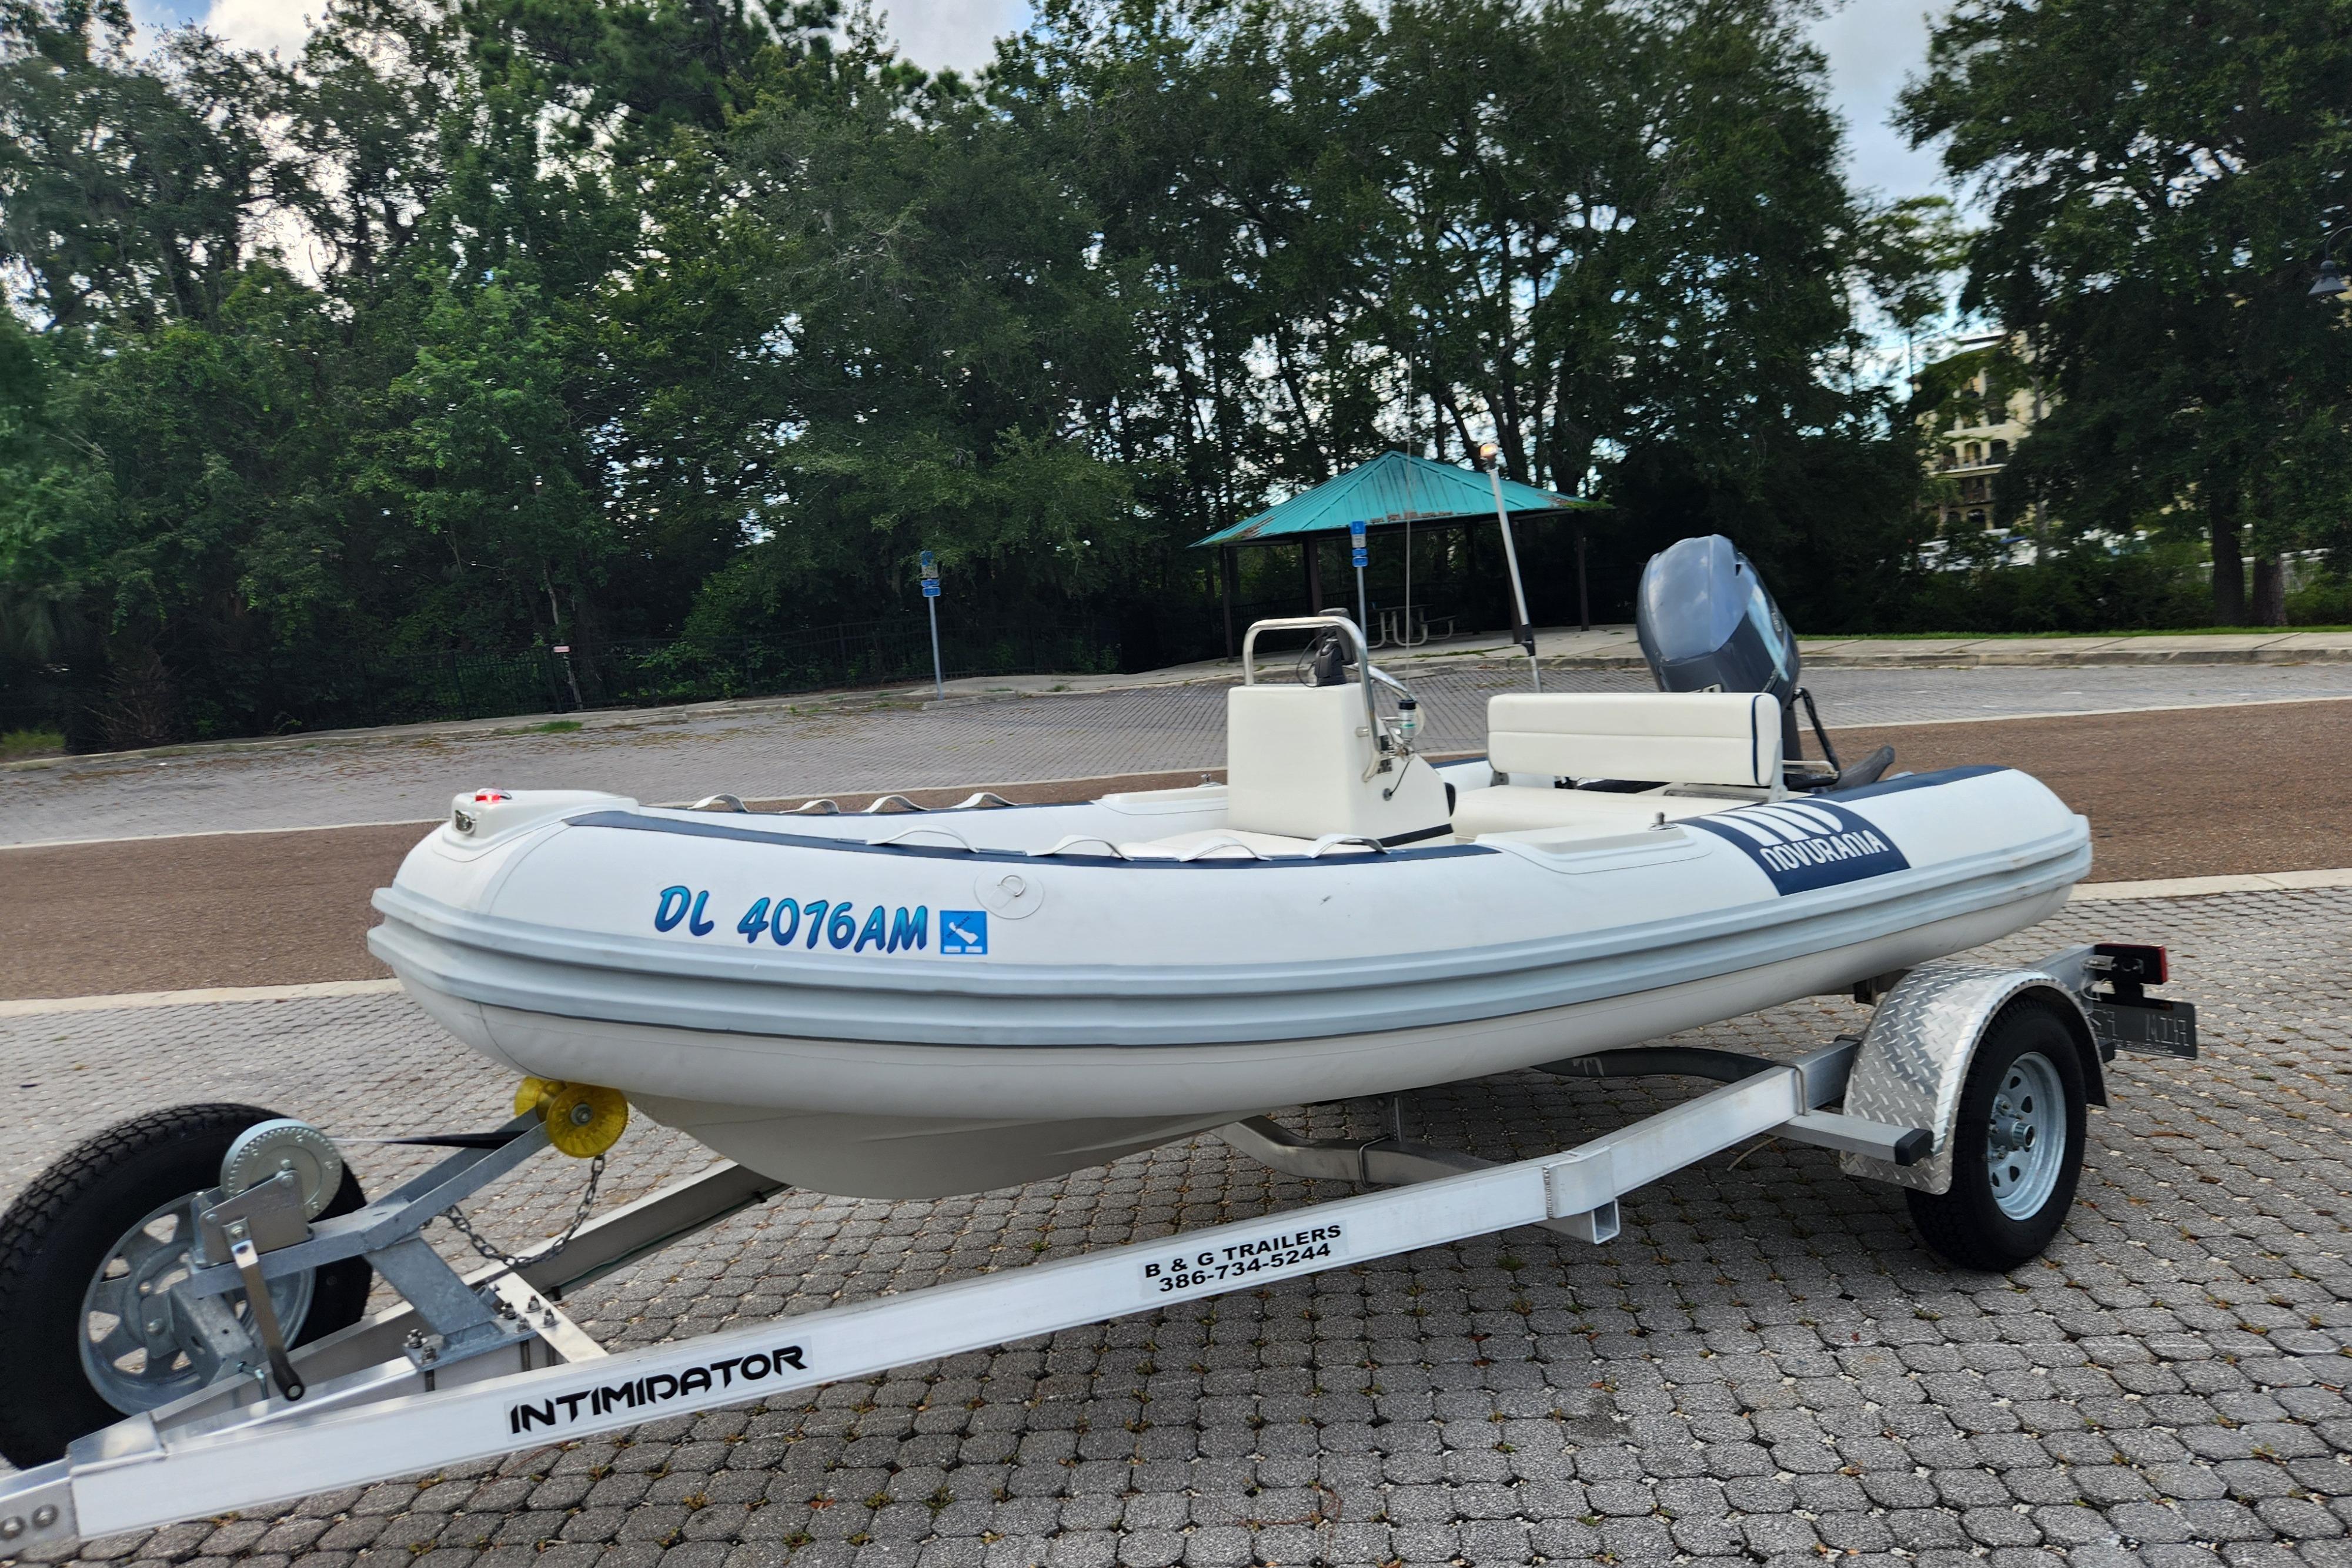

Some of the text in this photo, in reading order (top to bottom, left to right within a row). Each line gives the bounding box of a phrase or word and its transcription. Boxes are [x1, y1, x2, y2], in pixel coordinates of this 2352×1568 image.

[1759, 830, 1889, 872] NOVURANIA
[654, 885, 714, 937] DL
[737, 897, 928, 954] 4076AM
[1145, 1225, 1341, 1278] B & G TRAILERS
[1158, 1243, 1331, 1292] 386-734-5244
[510, 1345, 808, 1434] INTIMIDATOR
